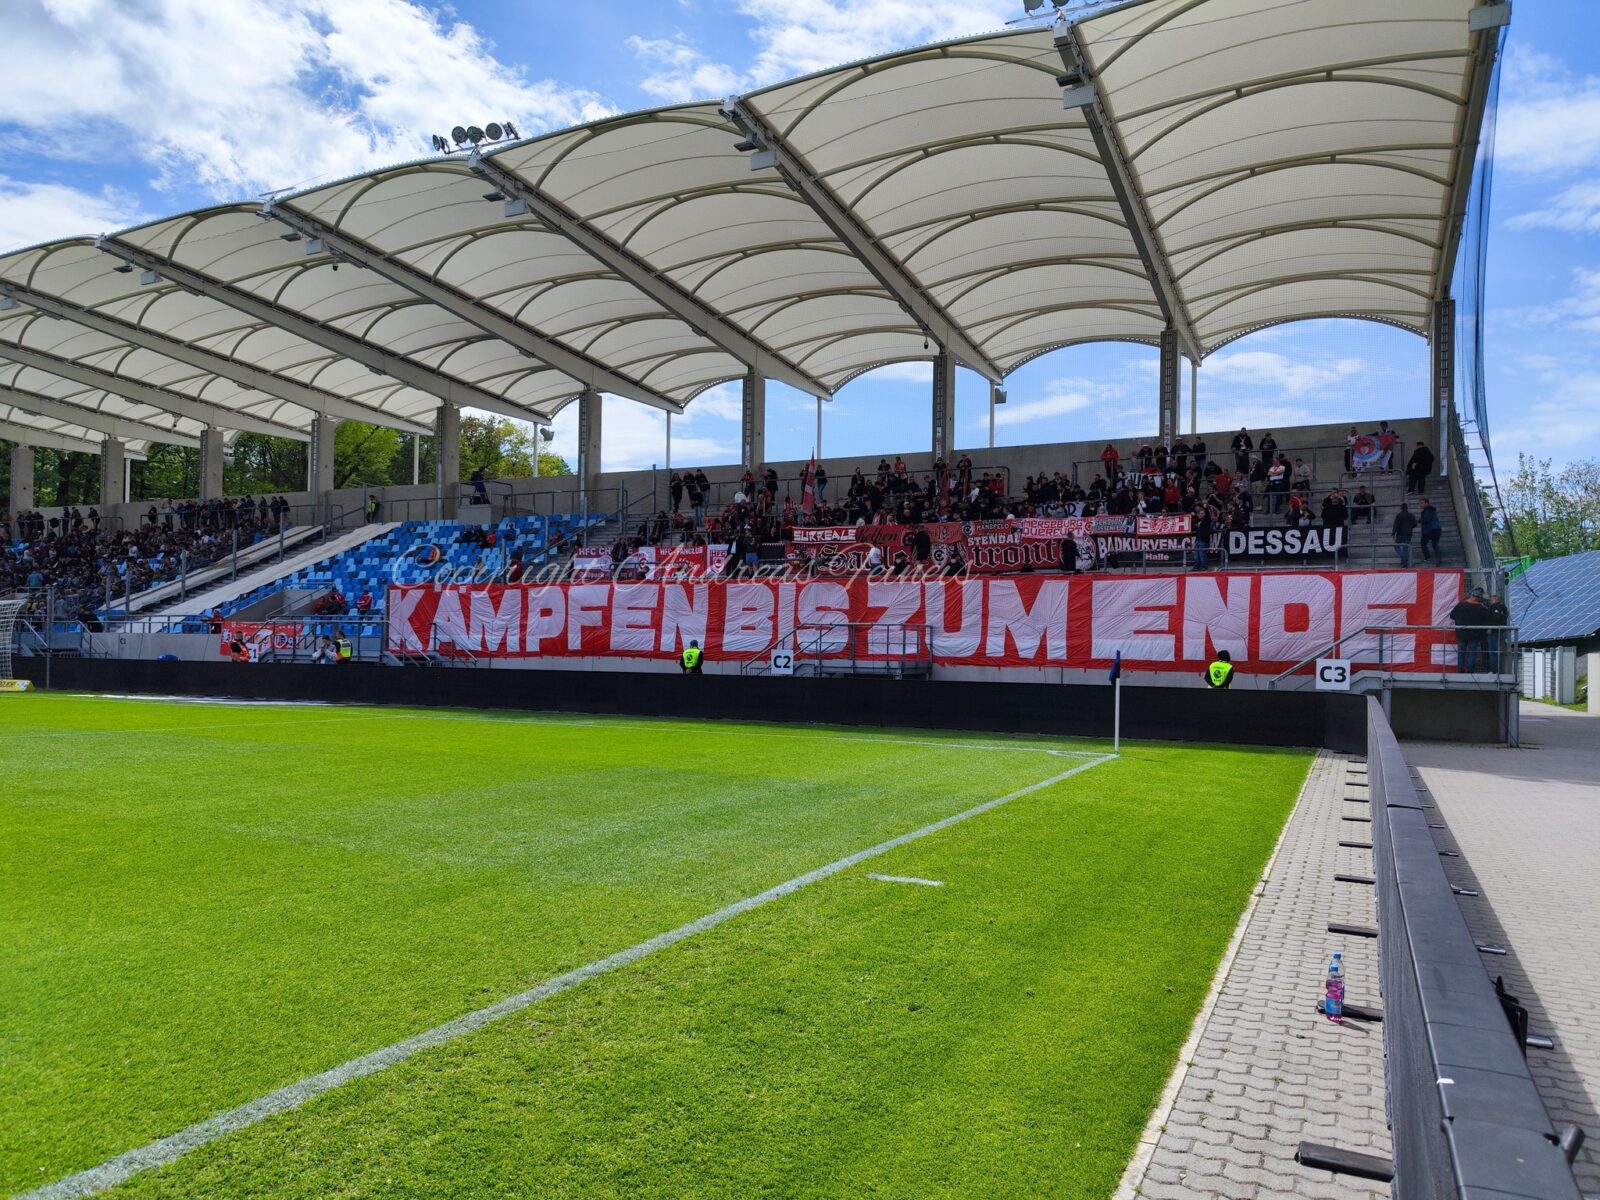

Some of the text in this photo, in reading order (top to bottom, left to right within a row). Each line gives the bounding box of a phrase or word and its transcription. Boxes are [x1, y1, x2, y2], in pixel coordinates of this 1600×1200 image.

[976, 523, 1010, 531] MANSFELD
[793, 528, 857, 543] SURREALE
[967, 533, 1022, 547] STENDAL
[1228, 526, 1344, 555] DESSAU
[578, 547, 597, 555] HFC
[598, 546, 633, 555] CHE
[1145, 553, 1170, 561] Halle
[389, 571, 1461, 666] KÄMPFEN BIS ZUM ENDE!
[773, 654, 791, 669] C2
[1319, 665, 1348, 683] C3
